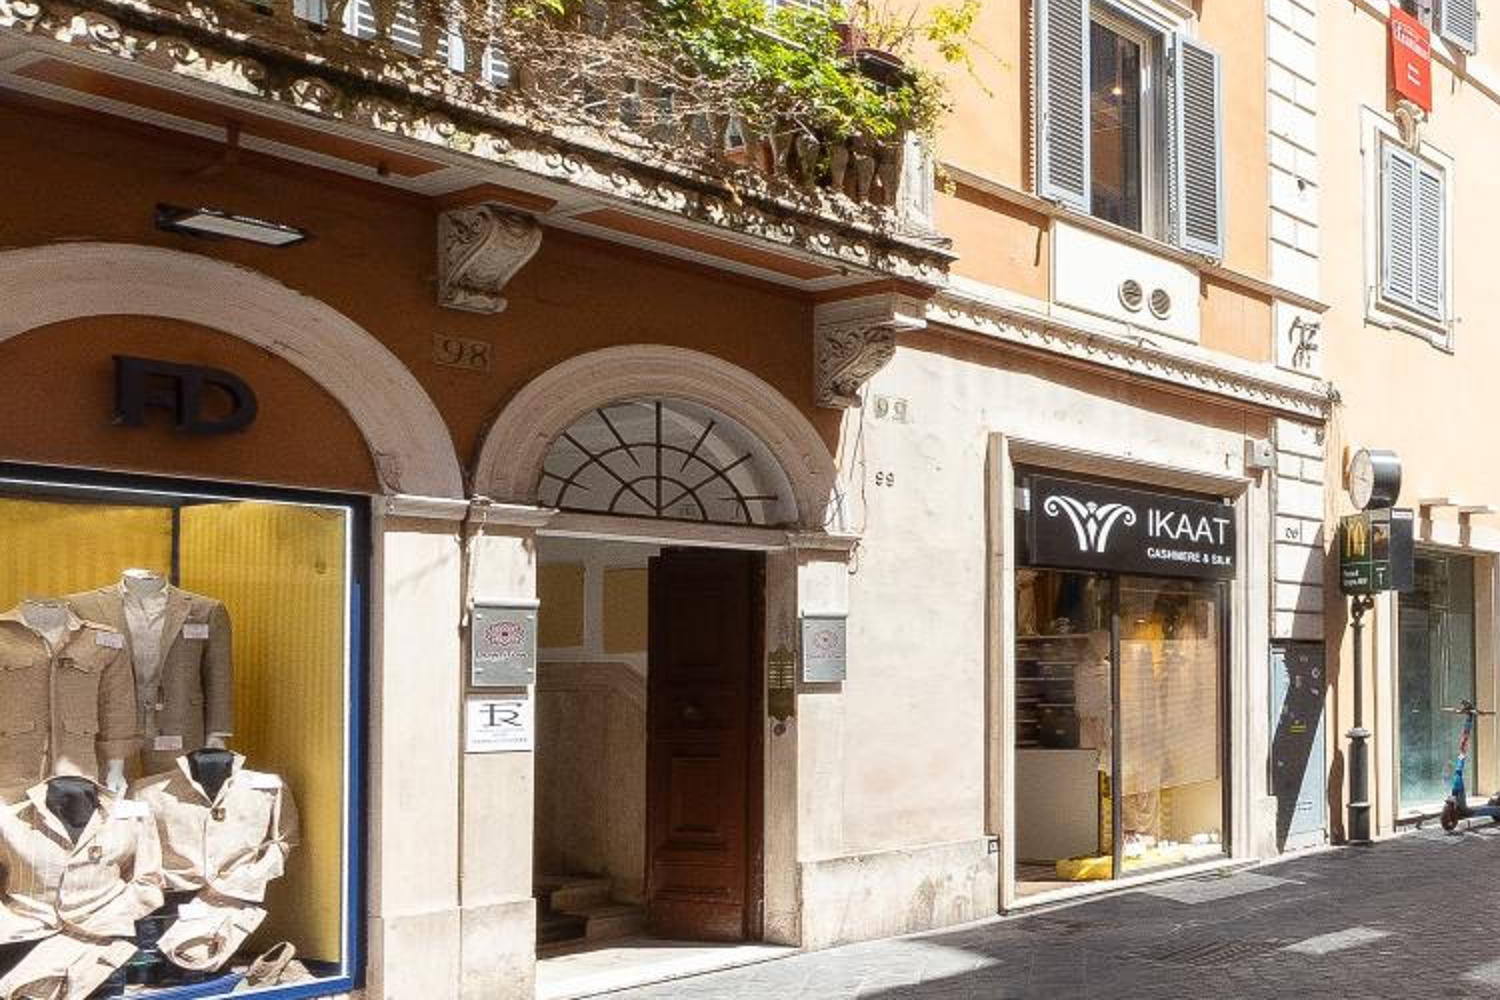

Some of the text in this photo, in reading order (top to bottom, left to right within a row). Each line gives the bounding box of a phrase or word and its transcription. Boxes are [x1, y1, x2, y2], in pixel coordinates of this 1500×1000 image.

[443, 339, 488, 368] 98
[1148, 508, 1231, 545] IKAAT
[1147, 547, 1201, 563] CASHMERE
